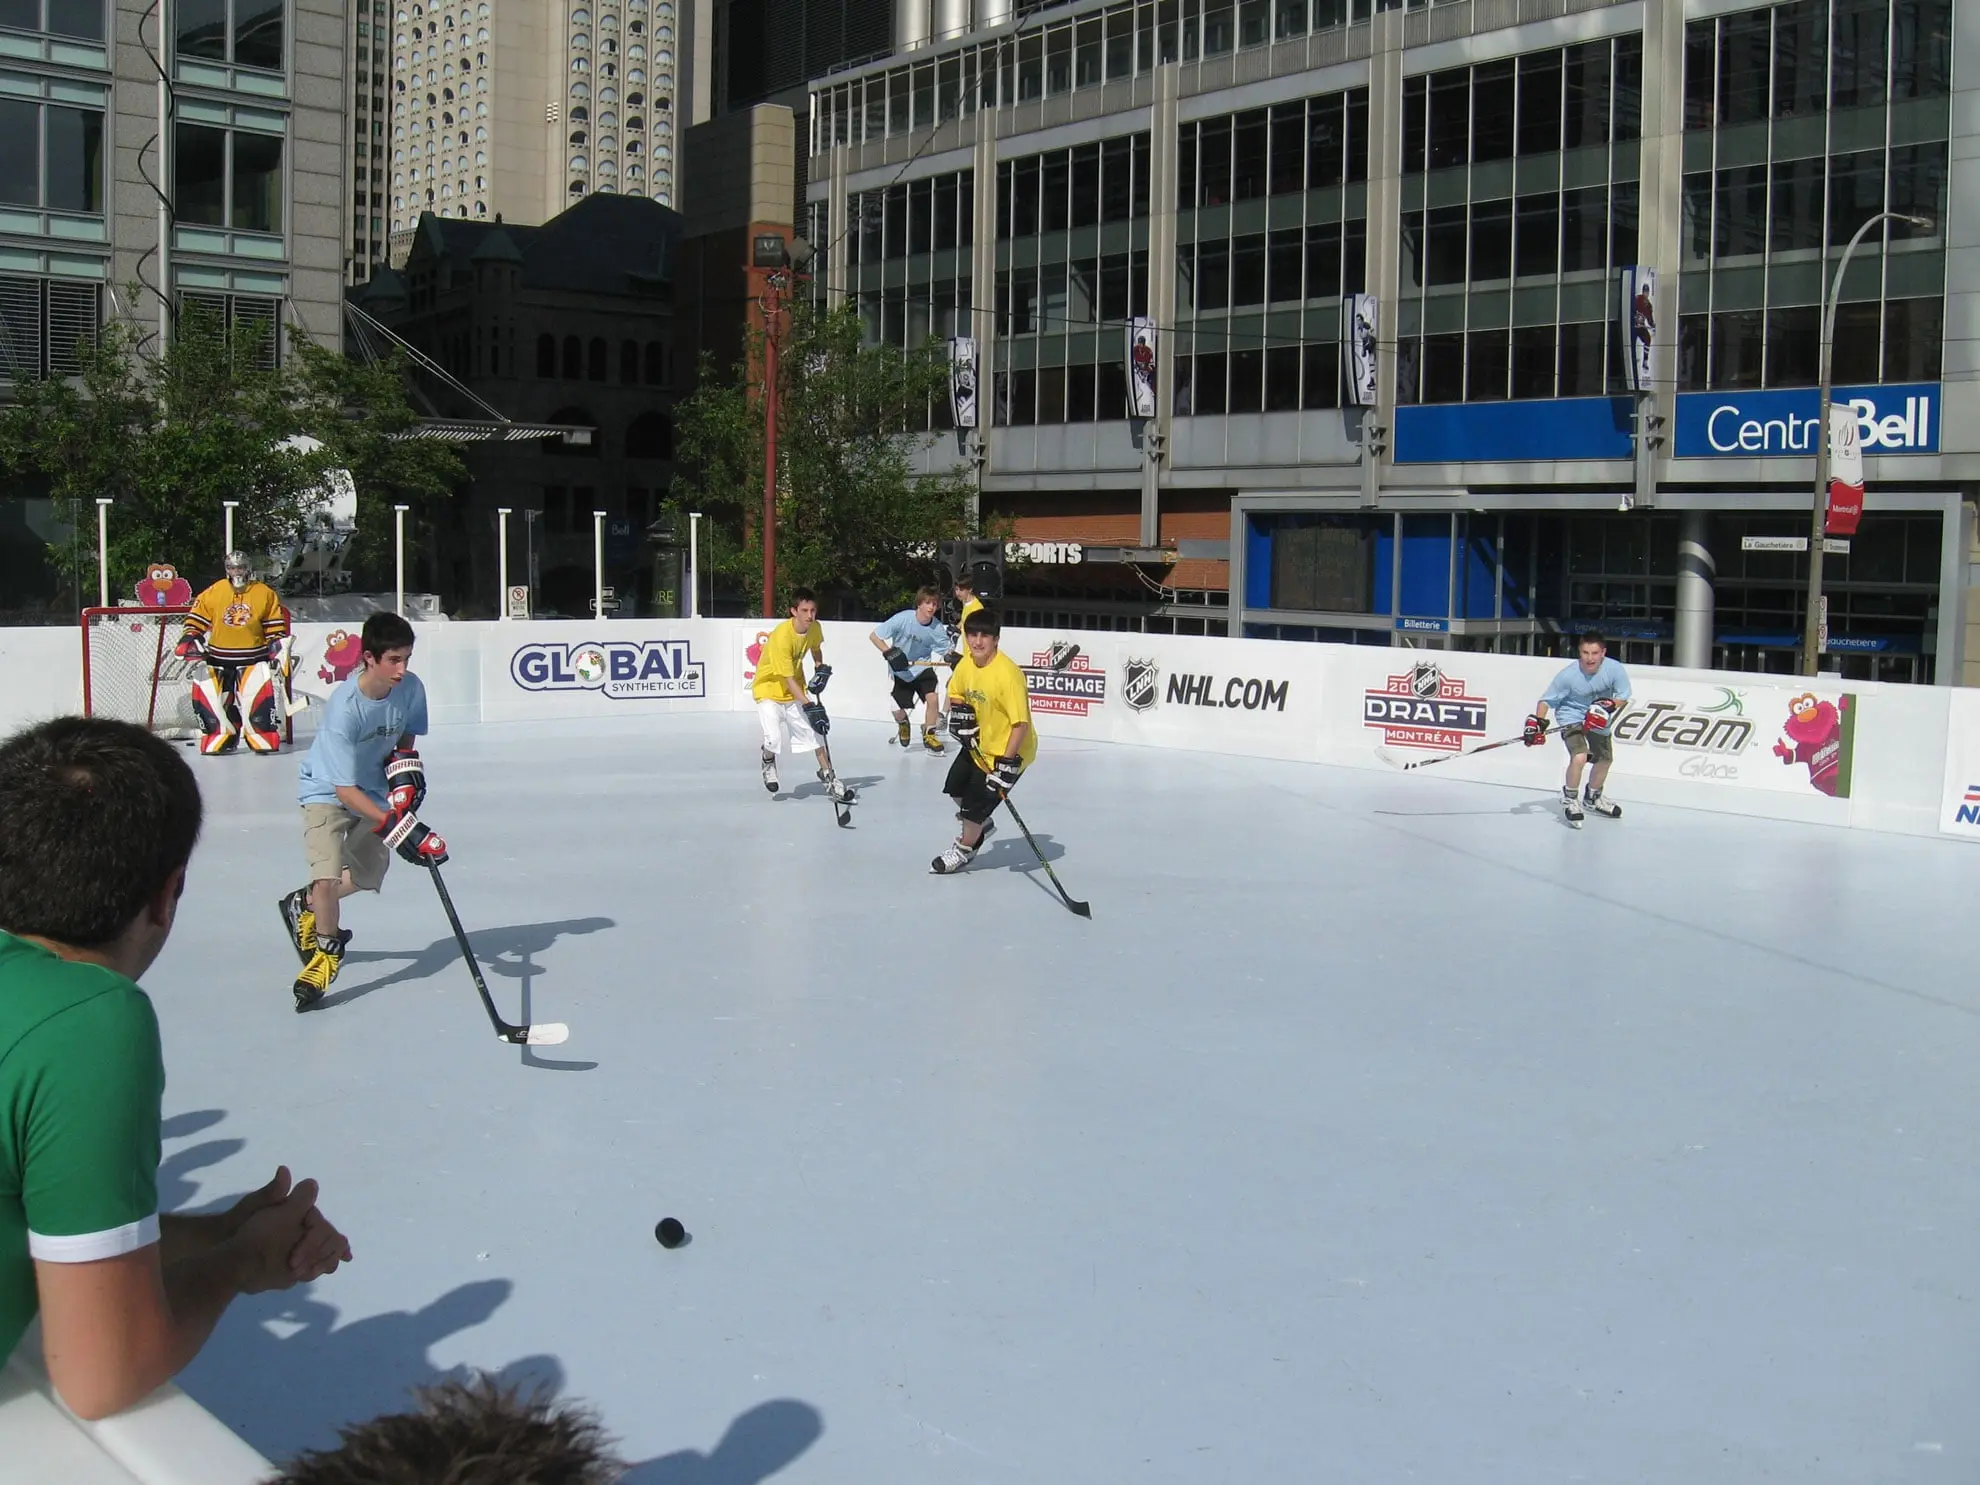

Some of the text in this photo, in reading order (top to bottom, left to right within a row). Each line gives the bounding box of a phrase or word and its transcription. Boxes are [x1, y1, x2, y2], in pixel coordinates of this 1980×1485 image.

[1707, 405, 1820, 452] Centr
[611, 524, 629, 537] Bell
[1005, 542, 1082, 564] SPORTS
[1404, 619, 1441, 630] Billetterie
[1033, 658, 1088, 670] 20 09
[611, 682, 697, 692] SYNTHETIC ICE
[1128, 670, 1154, 699] LNH
[1388, 682, 1463, 697] 20 09
[1166, 673, 1290, 712] NHL.COM
[1031, 699, 1087, 711] MONTRÉAL
[1366, 699, 1486, 726] DRAFT
[1386, 730, 1461, 745] MONTRÉAL
